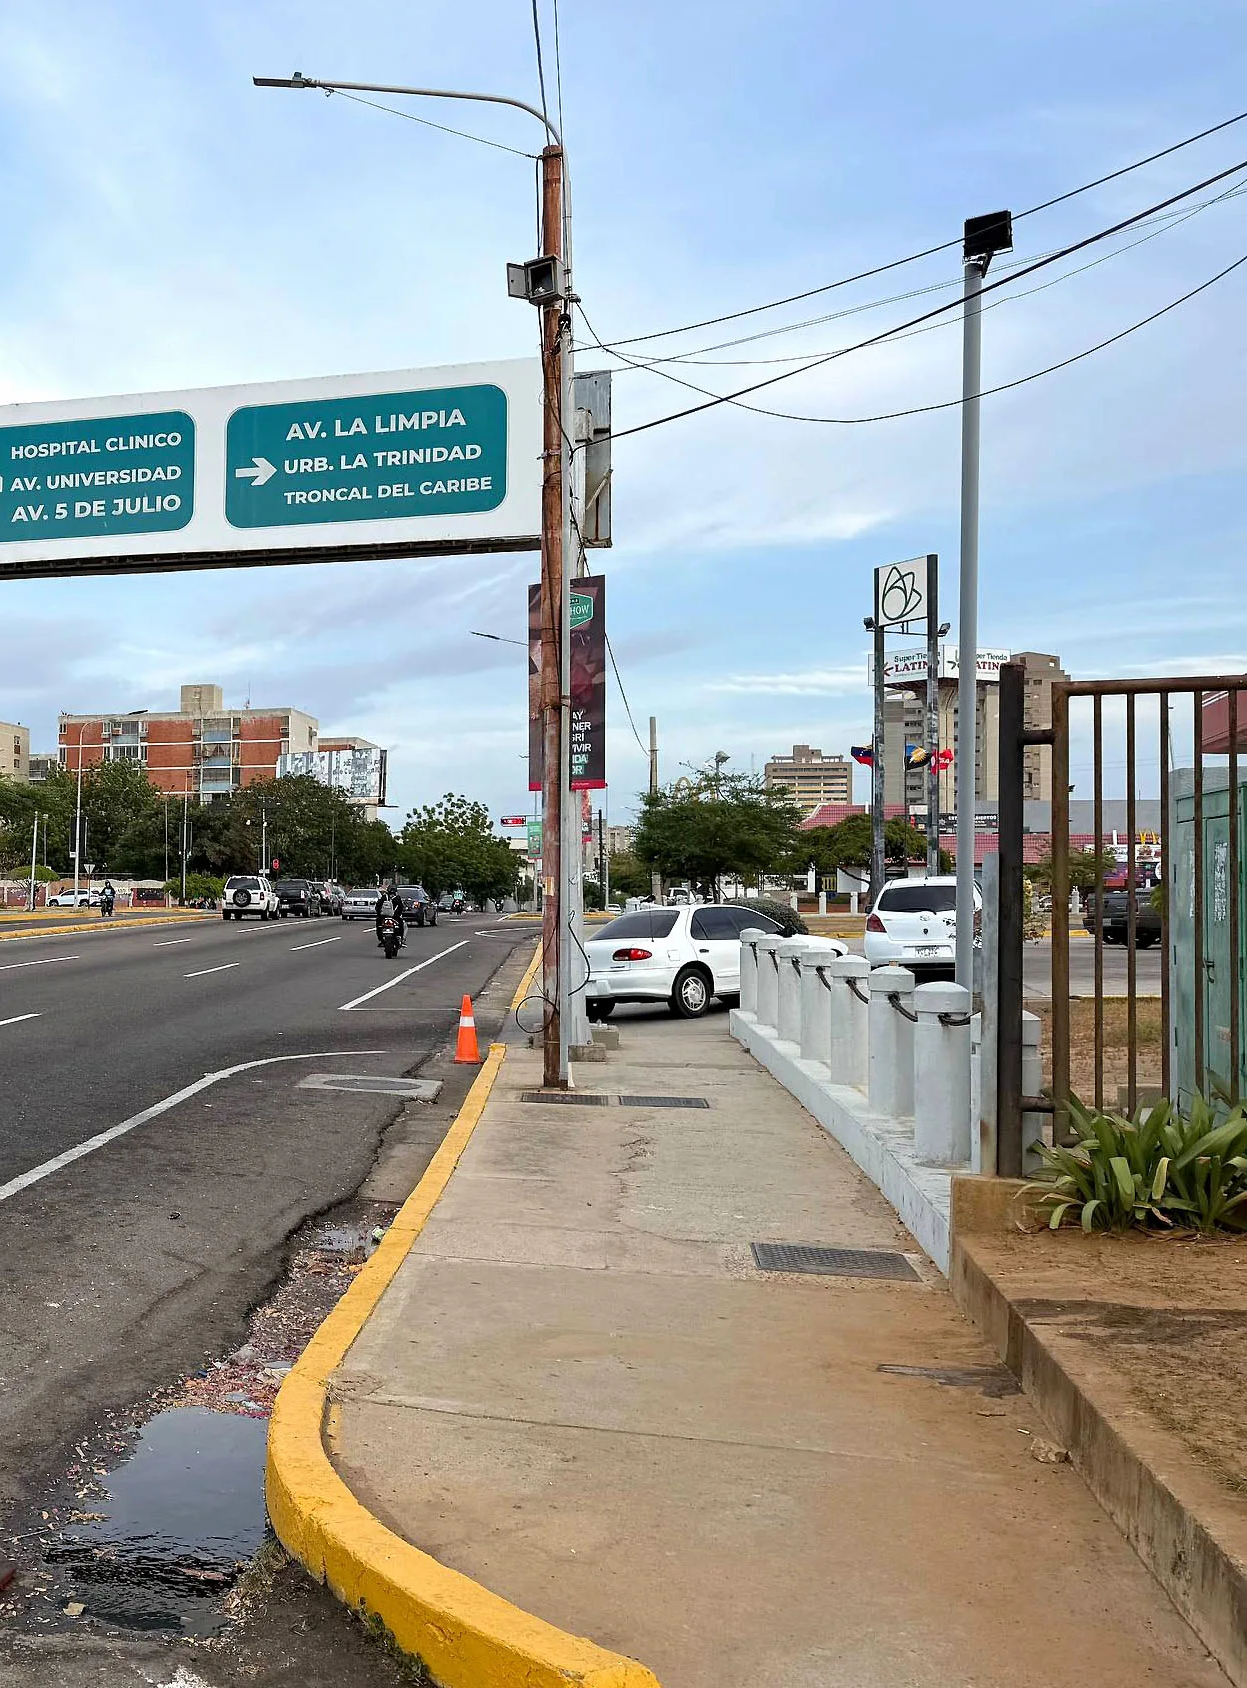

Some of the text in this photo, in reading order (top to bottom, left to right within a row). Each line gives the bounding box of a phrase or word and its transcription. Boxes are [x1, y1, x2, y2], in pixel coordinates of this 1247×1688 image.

[286, 408, 467, 441] AV. LA LIMPIA
[11, 432, 182, 460] HOSPITAL CLINICO
[284, 445, 482, 474] URB. LA TRINIDAD
[10, 466, 182, 492] AV. UNIVERSIDAD
[284, 477, 492, 505] TRONCAL DEL CARIBE
[11, 495, 181, 523] AV. 5 DE JULIO
[570, 604, 590, 616] HOW
[895, 659, 940, 673] LATIN
[572, 721, 592, 731] NER
